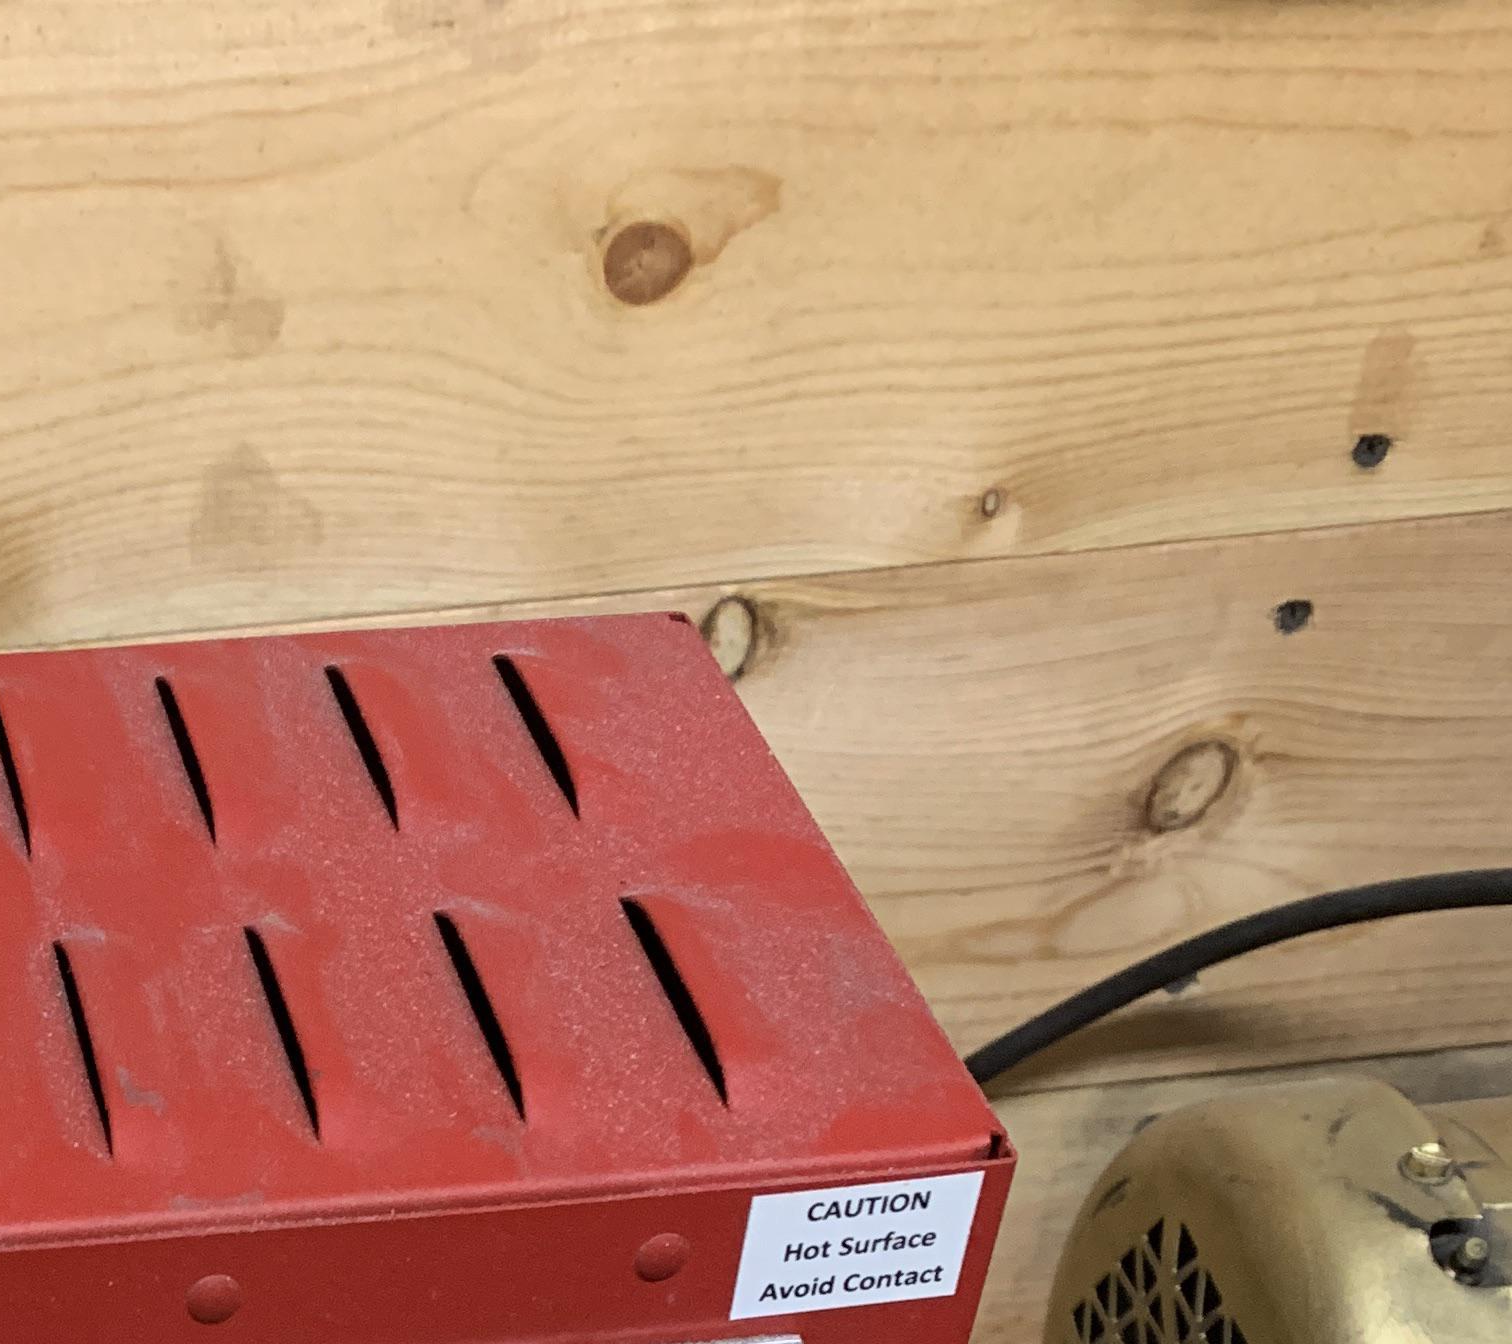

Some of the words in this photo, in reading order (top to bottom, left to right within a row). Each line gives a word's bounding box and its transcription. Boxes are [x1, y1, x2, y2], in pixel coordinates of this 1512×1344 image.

[807, 1191, 932, 1222] CAUTION
[783, 1242, 831, 1262] Hot
[838, 1231, 937, 1257] Surface
[759, 1276, 835, 1301] Avoid
[843, 1265, 944, 1293] Contact
